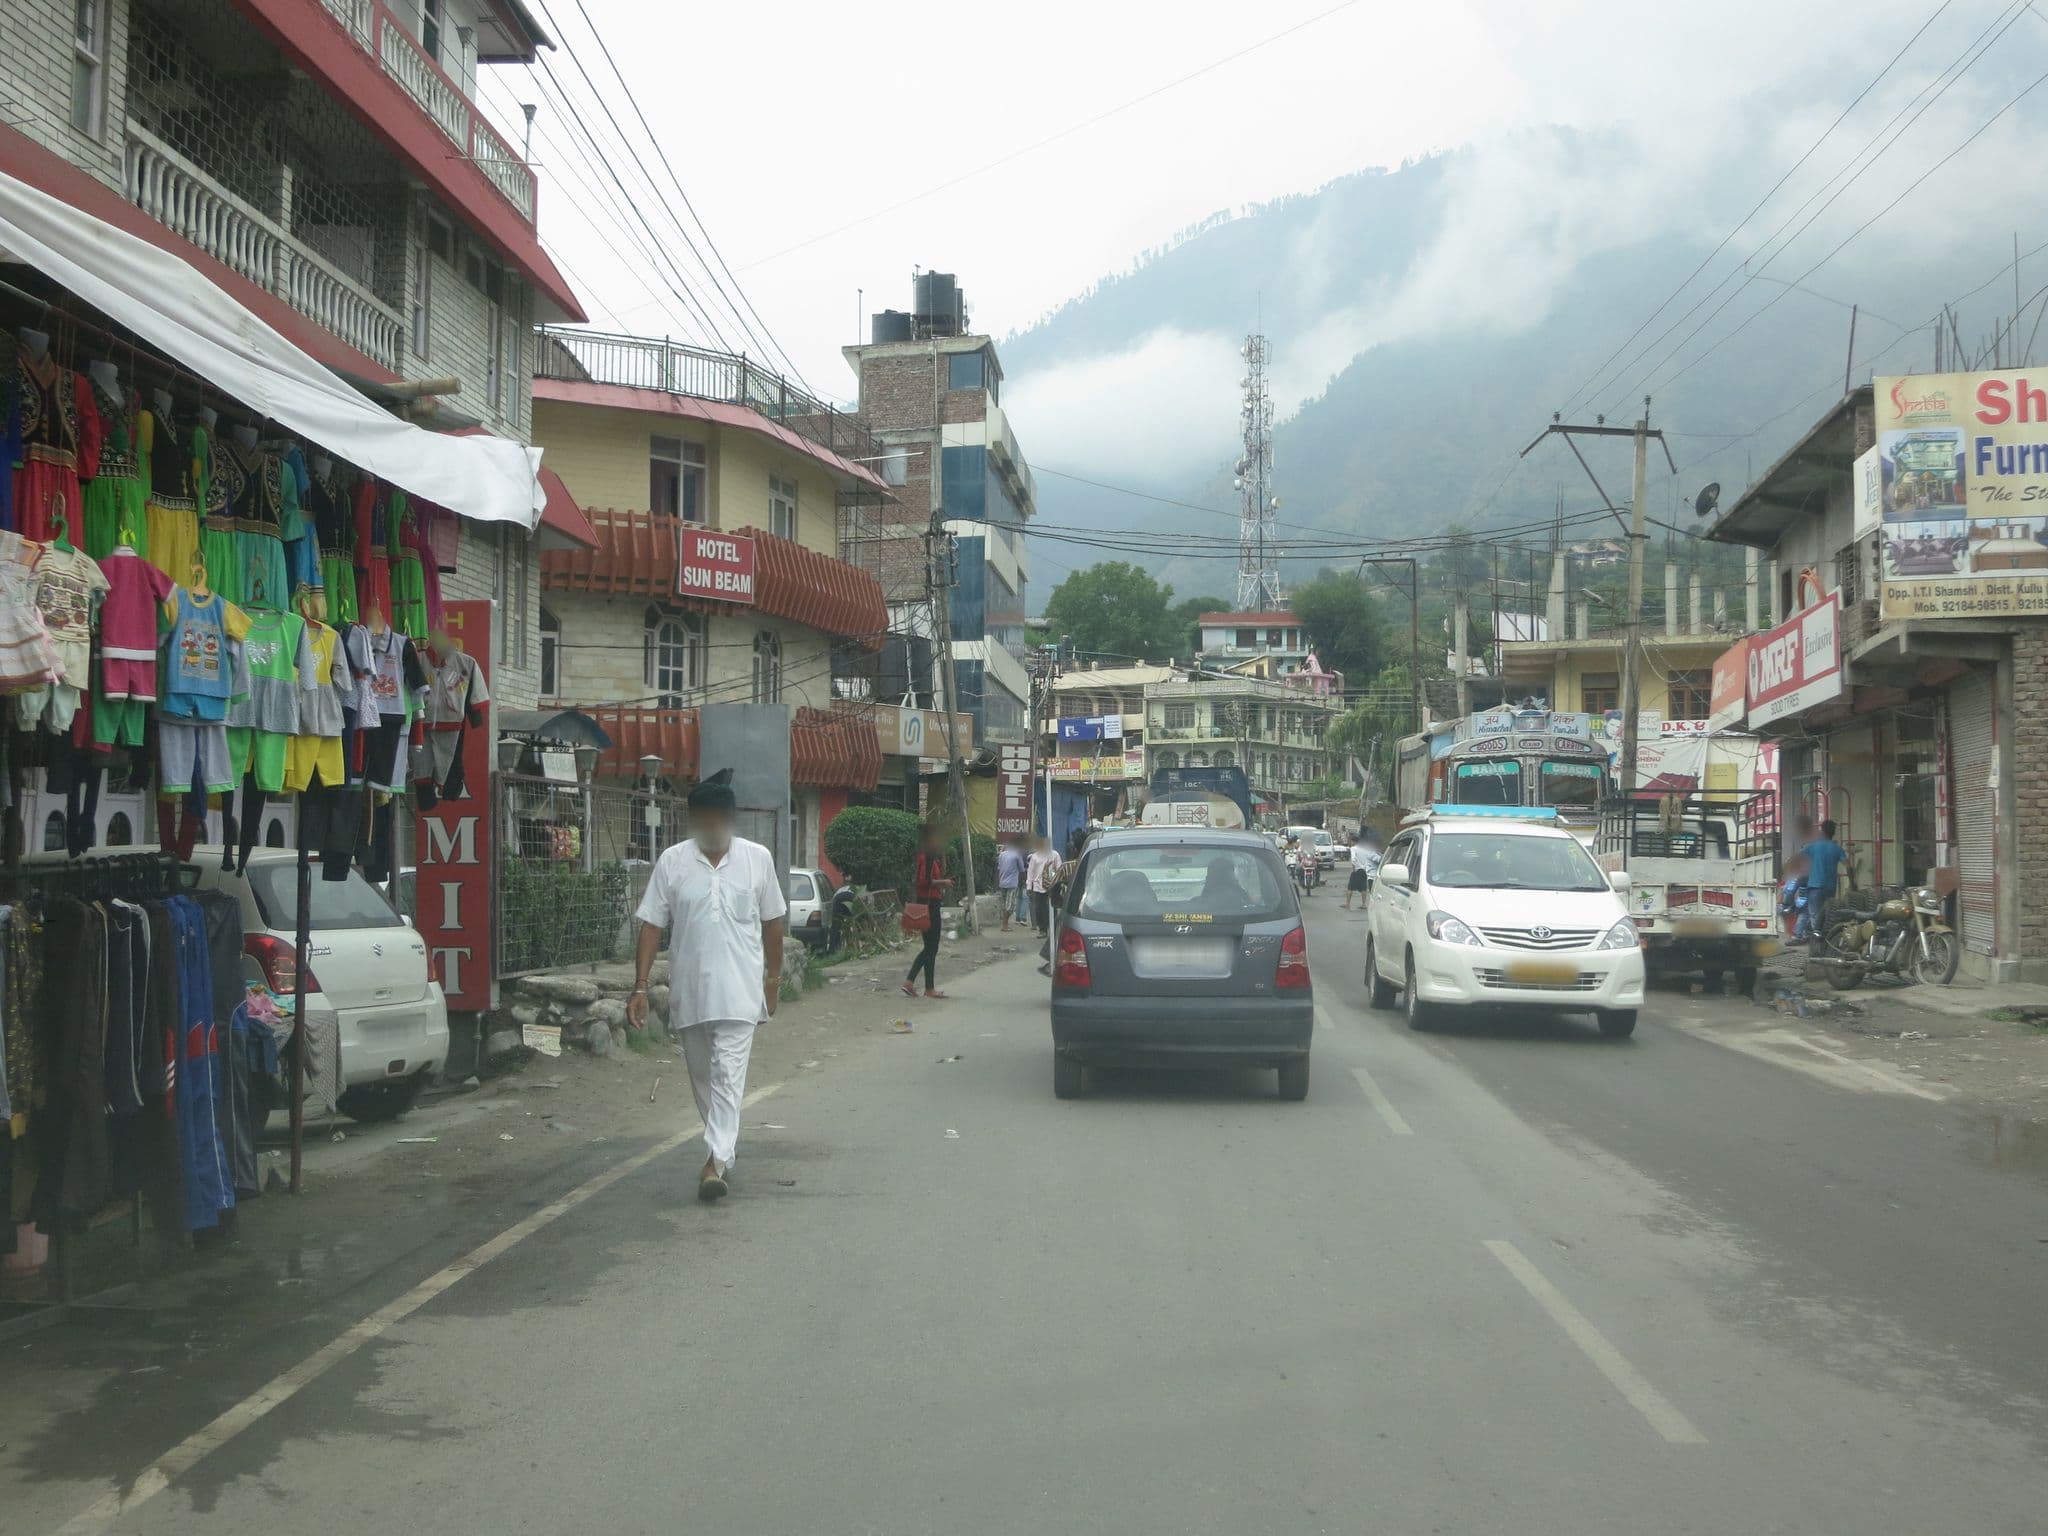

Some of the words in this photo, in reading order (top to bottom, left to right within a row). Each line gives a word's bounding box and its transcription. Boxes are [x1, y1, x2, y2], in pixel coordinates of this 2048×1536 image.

[1975, 379, 2047, 425] Sh
[1975, 437, 2048, 475] Furn
[696, 538, 740, 563] HOTEL
[684, 566, 711, 589] SUN
[715, 570, 751, 594] BEAM
[1888, 588, 1910, 600] Opp.
[1935, 584, 1977, 597] Shamshi
[2017, 583, 2043, 594] Kullu
[1915, 602, 1939, 612] Mob.
[1759, 628, 1799, 693] MRF
[1001, 746, 1031, 809] HOTEL
[997, 818, 1029, 833] SUNBEAM
[421, 785, 481, 995] MIT
